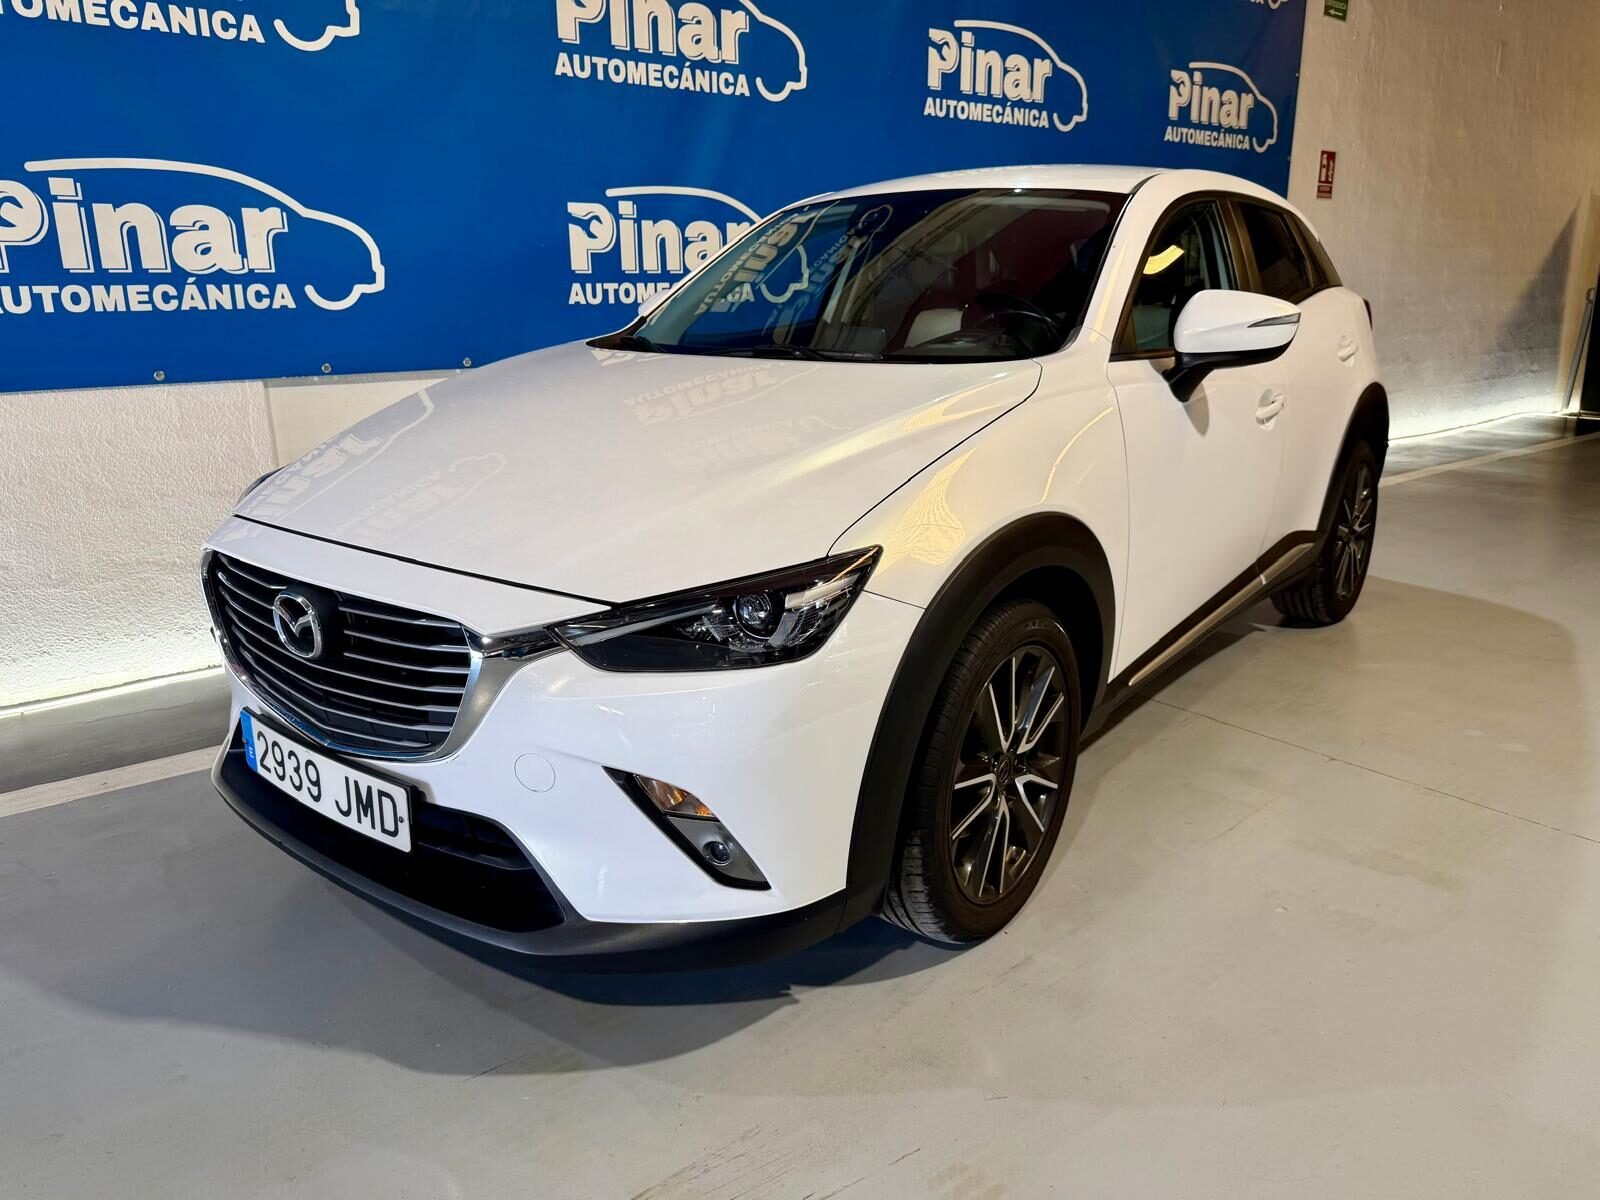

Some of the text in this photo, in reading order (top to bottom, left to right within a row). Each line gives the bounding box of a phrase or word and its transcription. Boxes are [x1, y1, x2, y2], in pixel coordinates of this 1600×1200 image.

[555, 0, 750, 64] Pinar
[555, 52, 750, 97] AUTOMECÁNICA
[927, 28, 1052, 103] Pinar
[923, 97, 1049, 129] AUTOMECÁNICA
[1168, 69, 1254, 129] Pinar
[1163, 125, 1250, 150] AUTOMECÁNICA
[0, 277, 296, 315] UTOMECÁNICA
[256, 730, 399, 838] 2939 JMD
